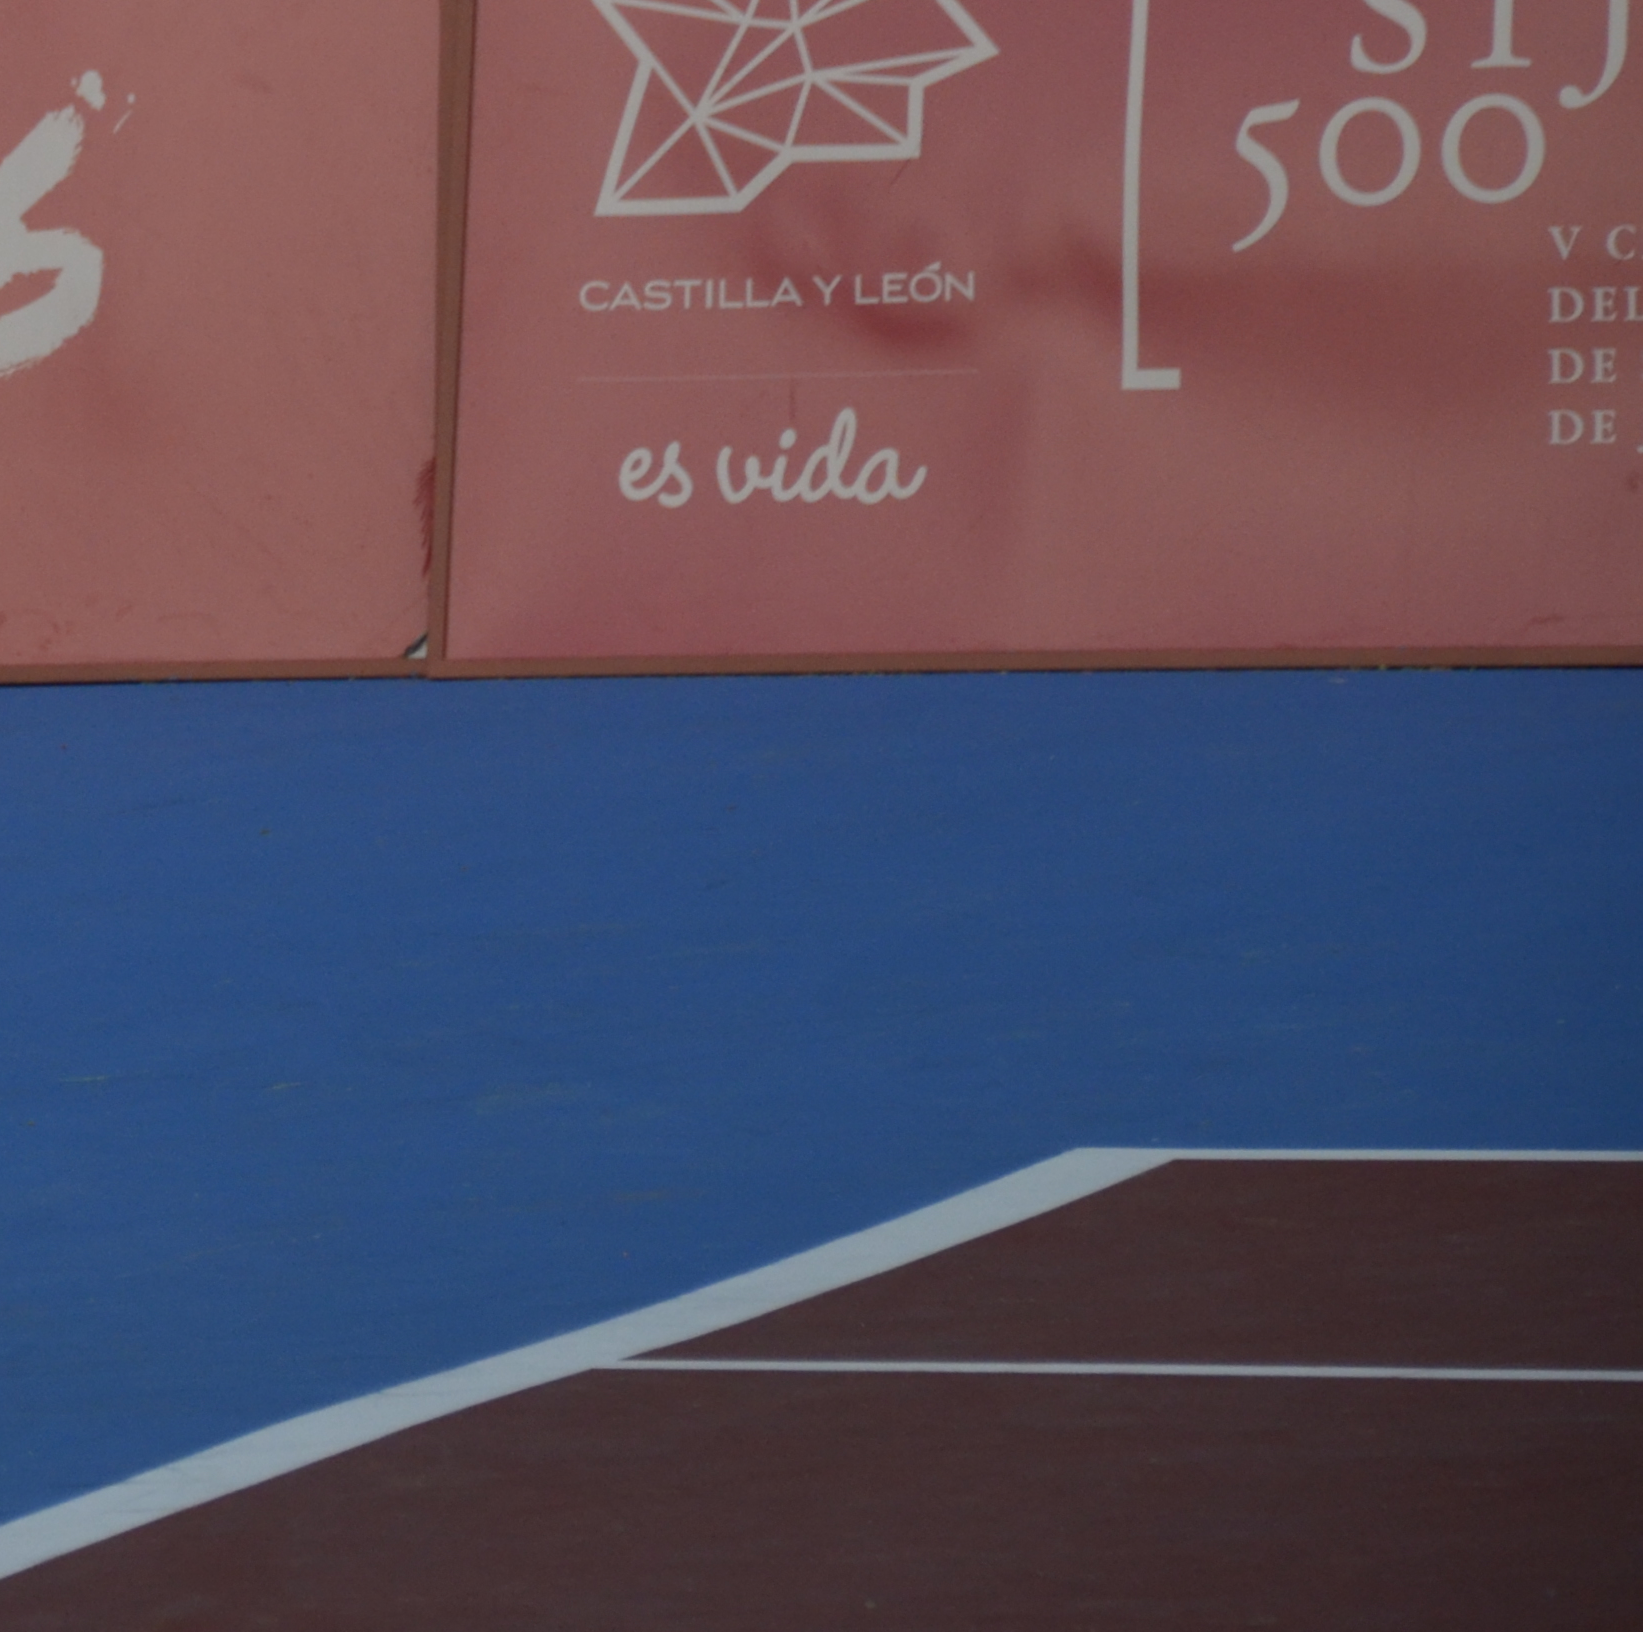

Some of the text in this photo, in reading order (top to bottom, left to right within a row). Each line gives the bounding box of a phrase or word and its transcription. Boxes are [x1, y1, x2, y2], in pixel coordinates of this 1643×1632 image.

[1231, 91, 1547, 253] 500
[1547, 225, 1583, 261] V
[578, 260, 976, 312] CASTILLA Y LEÓN
[1547, 347, 1617, 384] DE
[1547, 408, 1617, 446] DE
[618, 406, 929, 508] es vida
